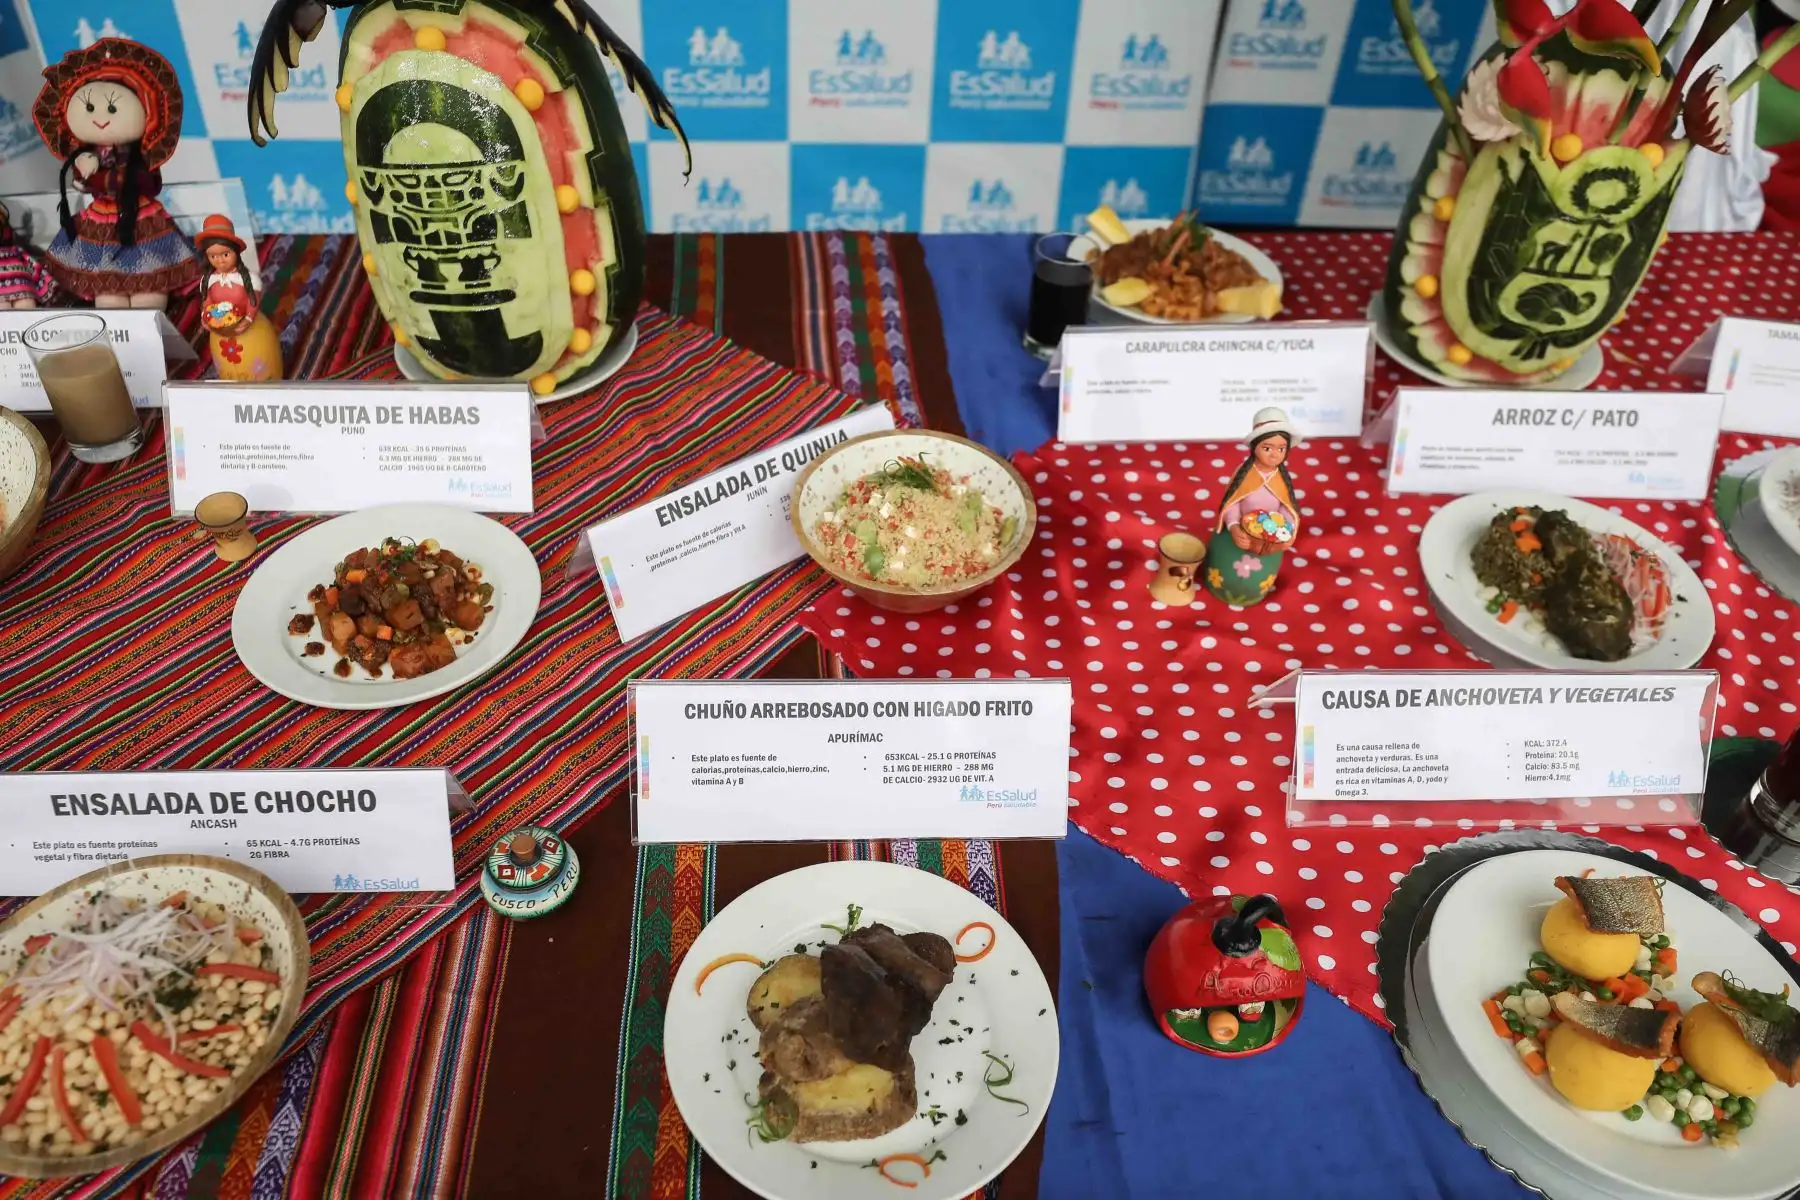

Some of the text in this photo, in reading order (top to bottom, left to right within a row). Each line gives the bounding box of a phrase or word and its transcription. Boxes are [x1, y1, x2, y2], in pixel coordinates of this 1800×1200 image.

[664, 67, 771, 94] EsSalud
[808, 69, 912, 94] EsSalud
[949, 71, 1056, 97] EsSalud
[1090, 74, 1191, 97] EsSalud
[1125, 340, 1206, 354] CARAPULCRA
[1208, 340, 1264, 353] CHINCHA
[234, 404, 481, 428] MATASQUITA DE HABAS
[1492, 408, 1640, 431] ARROZ C/ PATO
[341, 426, 366, 436] PUNO
[655, 470, 753, 527] ENSALADA
[753, 457, 780, 484] DE
[645, 553, 659, 563] Este
[659, 546, 675, 558] plato
[683, 534, 702, 546] fuente
[1322, 687, 1677, 710] CAUSA DE ANCHOVETA Y VEGETALES
[684, 699, 1034, 720] CHUÑO ARREBOSADO CON HIGADO FRITO
[827, 730, 884, 744] APURÍMAC
[1524, 738, 1567, 748] KCAL: 372.4
[1336, 744, 1345, 752] Es
[1362, 744, 1383, 752] causa
[1385, 743, 1410, 751] rellena
[1411, 742, 1420, 751] de
[691, 753, 777, 765] Este plato es fuente de
[885, 750, 997, 761] 653KCAL 25.1 G PROTEÍNAS
[1336, 755, 1373, 763] anchoveta
[1415, 753, 1424, 761] Es
[1558, 750, 1579, 760] 20.1g
[883, 763, 994, 773] 5.1 MG DE HIERRO 288 MG
[1336, 766, 1364, 774] entrada
[1402, 765, 1411, 773] La
[1412, 764, 1449, 772] anchoveta
[1525, 762, 1580, 771] Calcio: 83.5 mg
[691, 777, 724, 786] vitamina
[726, 777, 732, 785] A
[738, 777, 744, 785] B
[883, 776, 893, 784] DE
[927, 775, 948, 783] 2932
[949, 775, 960, 783] UG
[962, 774, 972, 783] DE
[974, 774, 987, 783] VIT.
[988, 774, 994, 782] A
[1345, 777, 1360, 785] rica
[1371, 776, 1406, 785] vitaminas
[1426, 776, 1442, 785] yodo
[1633, 774, 1681, 787] EsSalud
[987, 788, 1038, 802] EsSalud
[1335, 788, 1369, 798] Omega 3.
[50, 788, 377, 817] ENSALADA DE CHOCHO
[190, 818, 238, 829] ANCASH
[33, 841, 51, 850] Este
[53, 840, 75, 852] plato
[76, 841, 87, 850] es
[88, 840, 116, 849] fuente
[246, 836, 360, 848] 65 KCAL 4.7G PROTEÍNAS
[34, 852, 65, 863] vegetal
[73, 851, 93, 861] fibra
[249, 850, 290, 859] 2G FIBRA
[363, 877, 420, 890] EsSalud
[491, 860, 578, 909] CUSCO PERU
